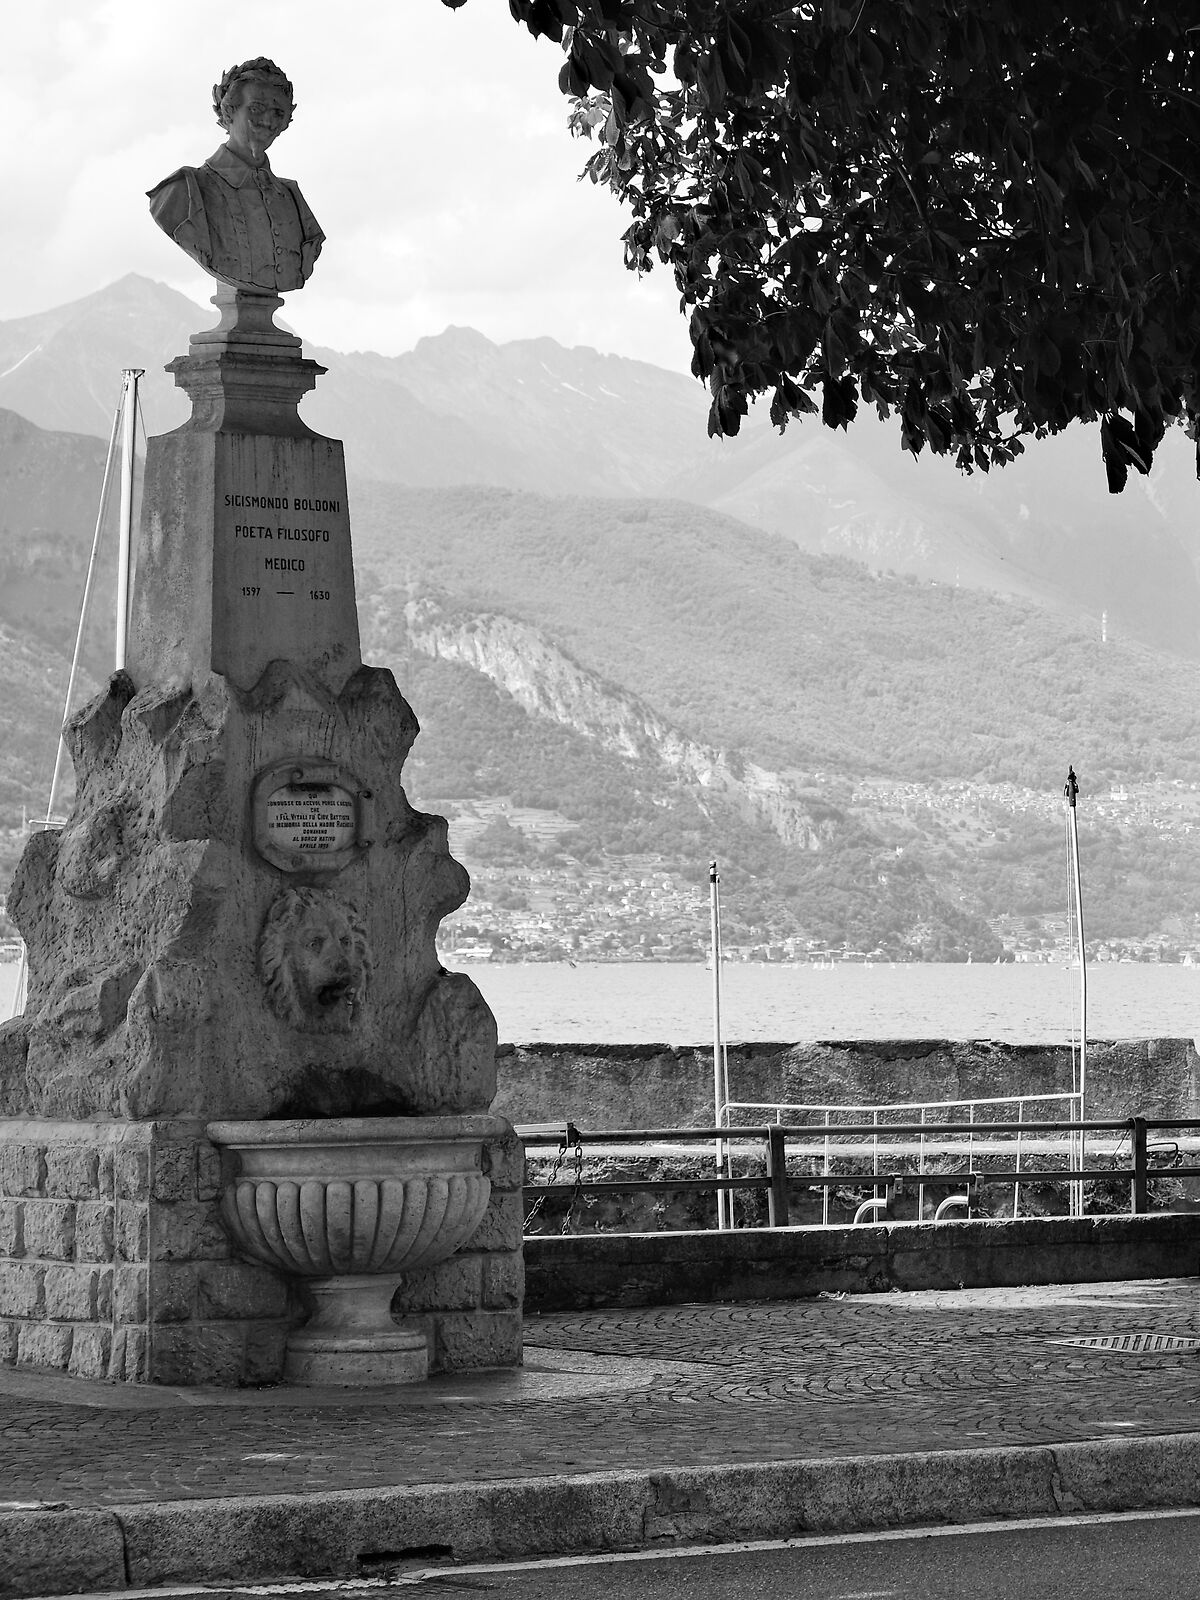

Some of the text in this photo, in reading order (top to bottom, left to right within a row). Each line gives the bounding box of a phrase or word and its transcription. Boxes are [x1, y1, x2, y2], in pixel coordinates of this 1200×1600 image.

[224, 494, 340, 513] SIGISMONDO BOLDONI
[235, 525, 330, 542] POETA FILOSOFO
[264, 557, 305, 572] MEDICO
[241, 586, 261, 597] 1597
[309, 590, 330, 600] 1630
